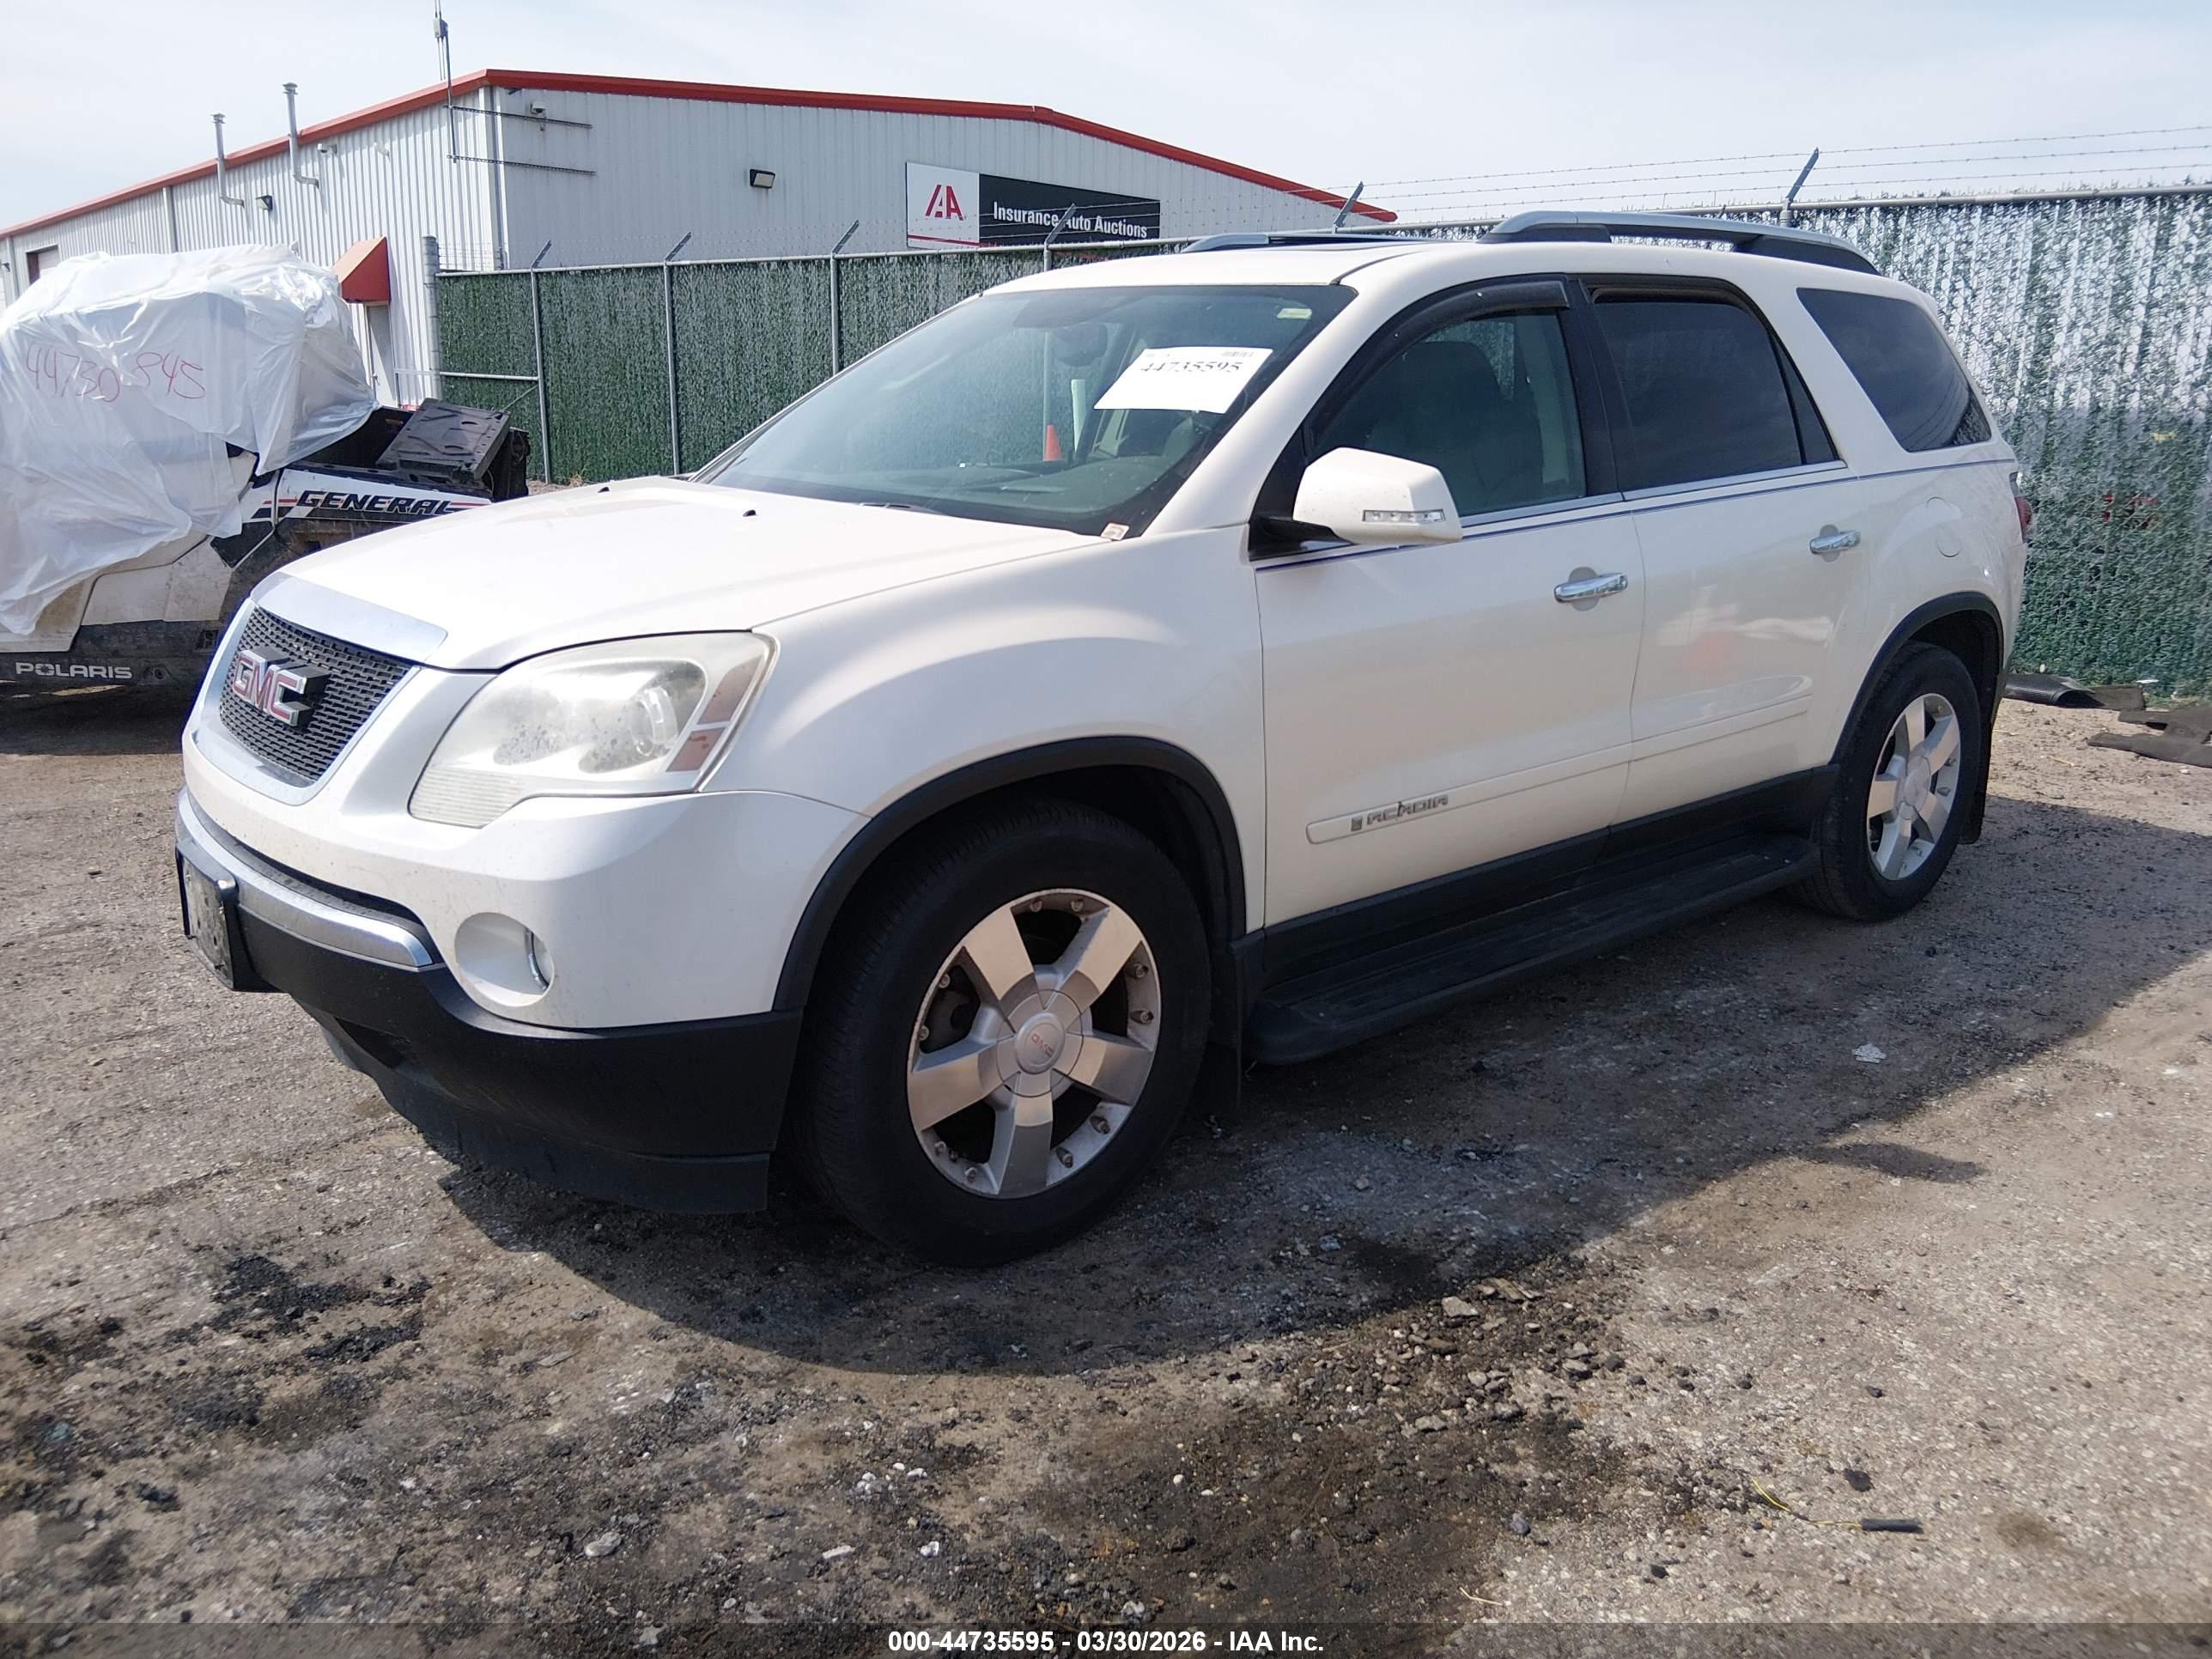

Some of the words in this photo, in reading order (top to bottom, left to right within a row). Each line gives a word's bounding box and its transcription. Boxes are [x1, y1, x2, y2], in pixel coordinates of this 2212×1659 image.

[993, 201, 1060, 228] Insurance
[1094, 215, 1147, 239] Auctions
[295, 489, 455, 515] GENERAL
[15, 662, 132, 679] POLARIS
[230, 649, 307, 727] GMC
[1366, 793, 1449, 826] ACADIA
[1031, 1033, 1055, 1058] GMC
